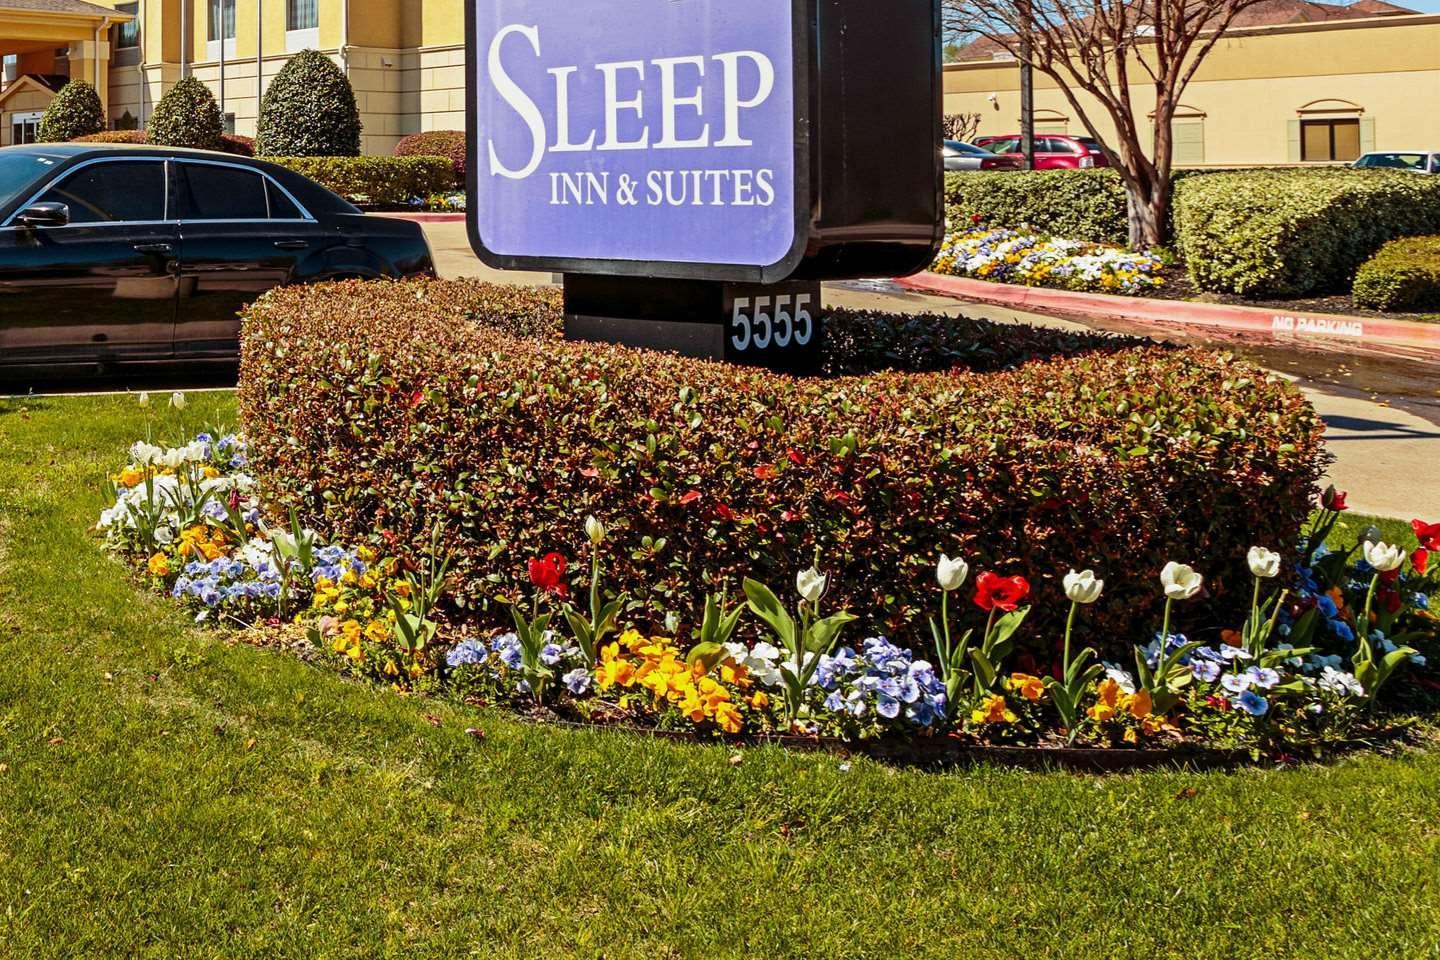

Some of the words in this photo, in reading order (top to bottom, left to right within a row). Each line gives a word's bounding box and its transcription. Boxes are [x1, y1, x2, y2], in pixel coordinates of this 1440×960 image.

[487, 24, 775, 180] SLEEP
[549, 171, 609, 205] INN
[616, 173, 638, 205] &
[646, 168, 775, 206] SUITES
[731, 293, 812, 351] 5555
[1271, 315, 1294, 330] NO
[1295, 317, 1363, 336] PARKING
